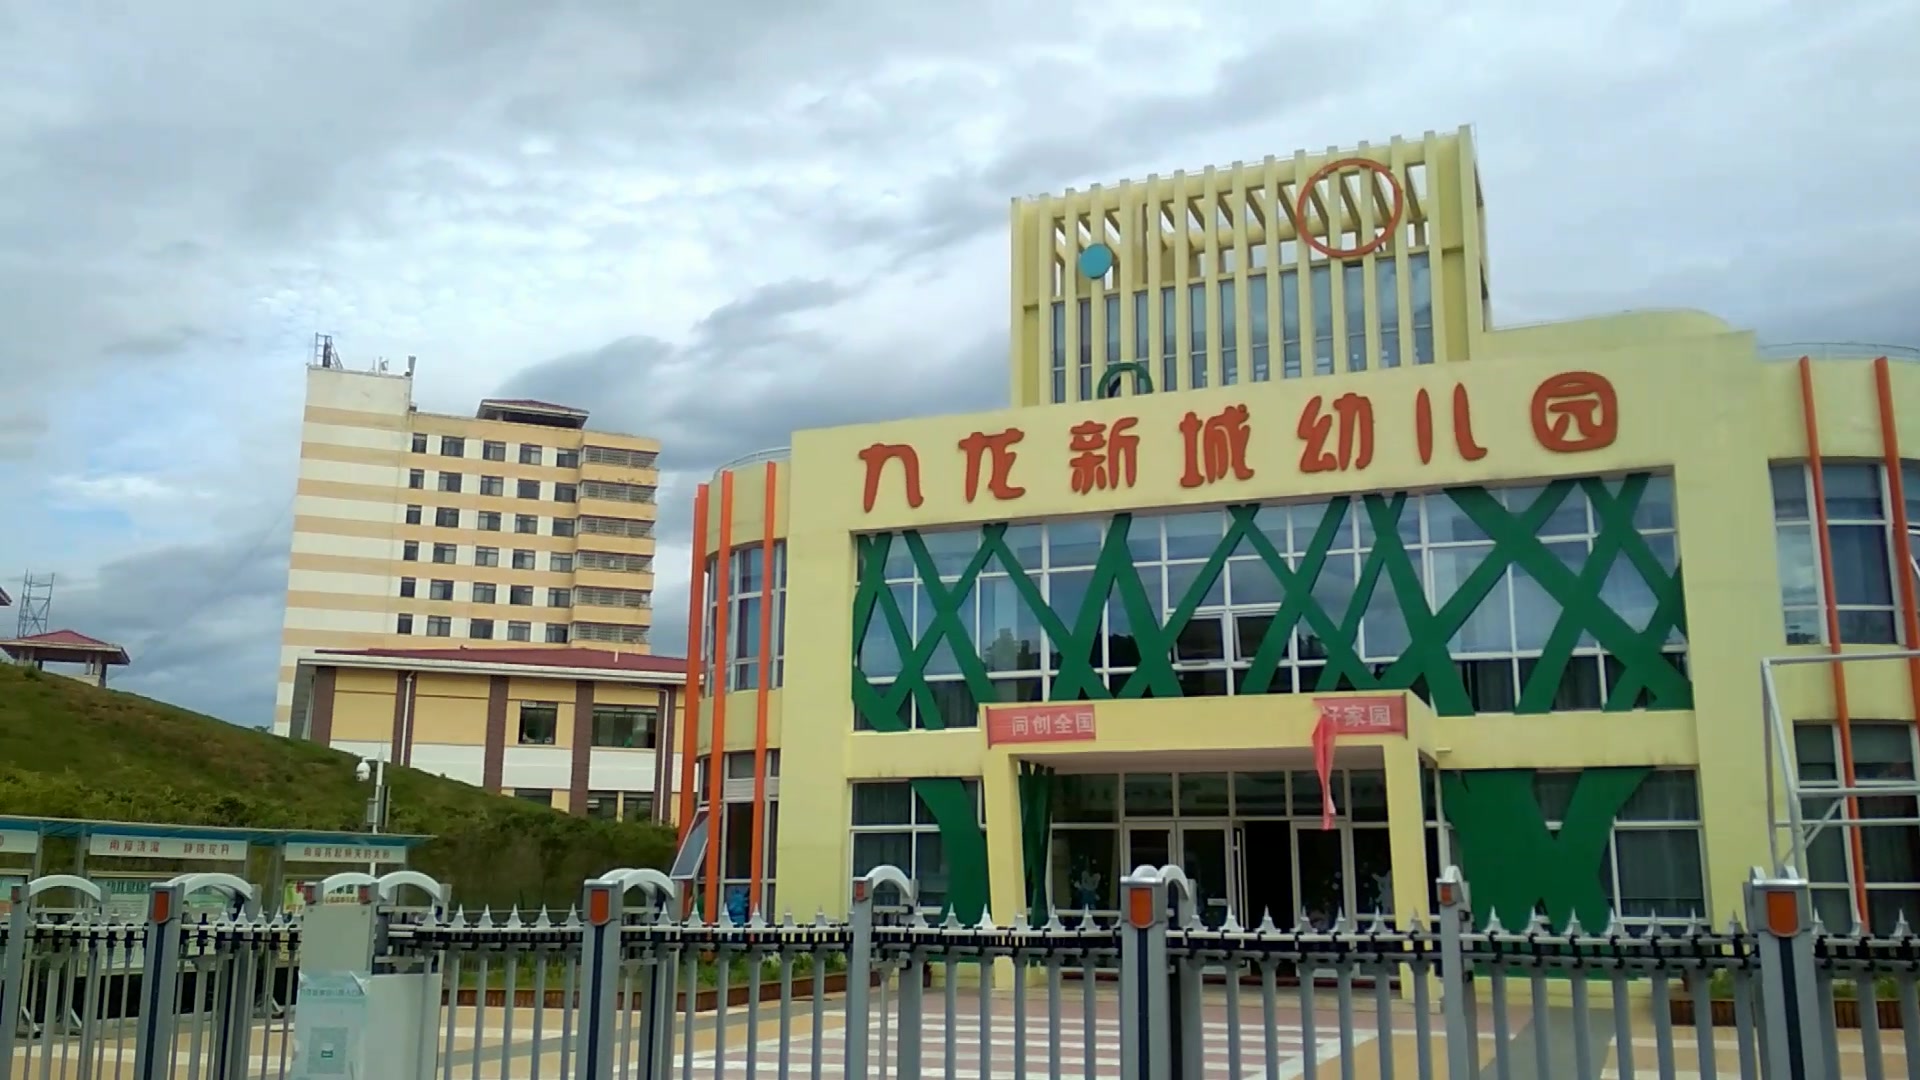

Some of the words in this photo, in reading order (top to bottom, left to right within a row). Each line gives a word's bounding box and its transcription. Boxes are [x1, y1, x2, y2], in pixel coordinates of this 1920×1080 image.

[859, 371, 1618, 513] 九龙新城幼儿园
[1012, 712, 1094, 736] 同创全国
